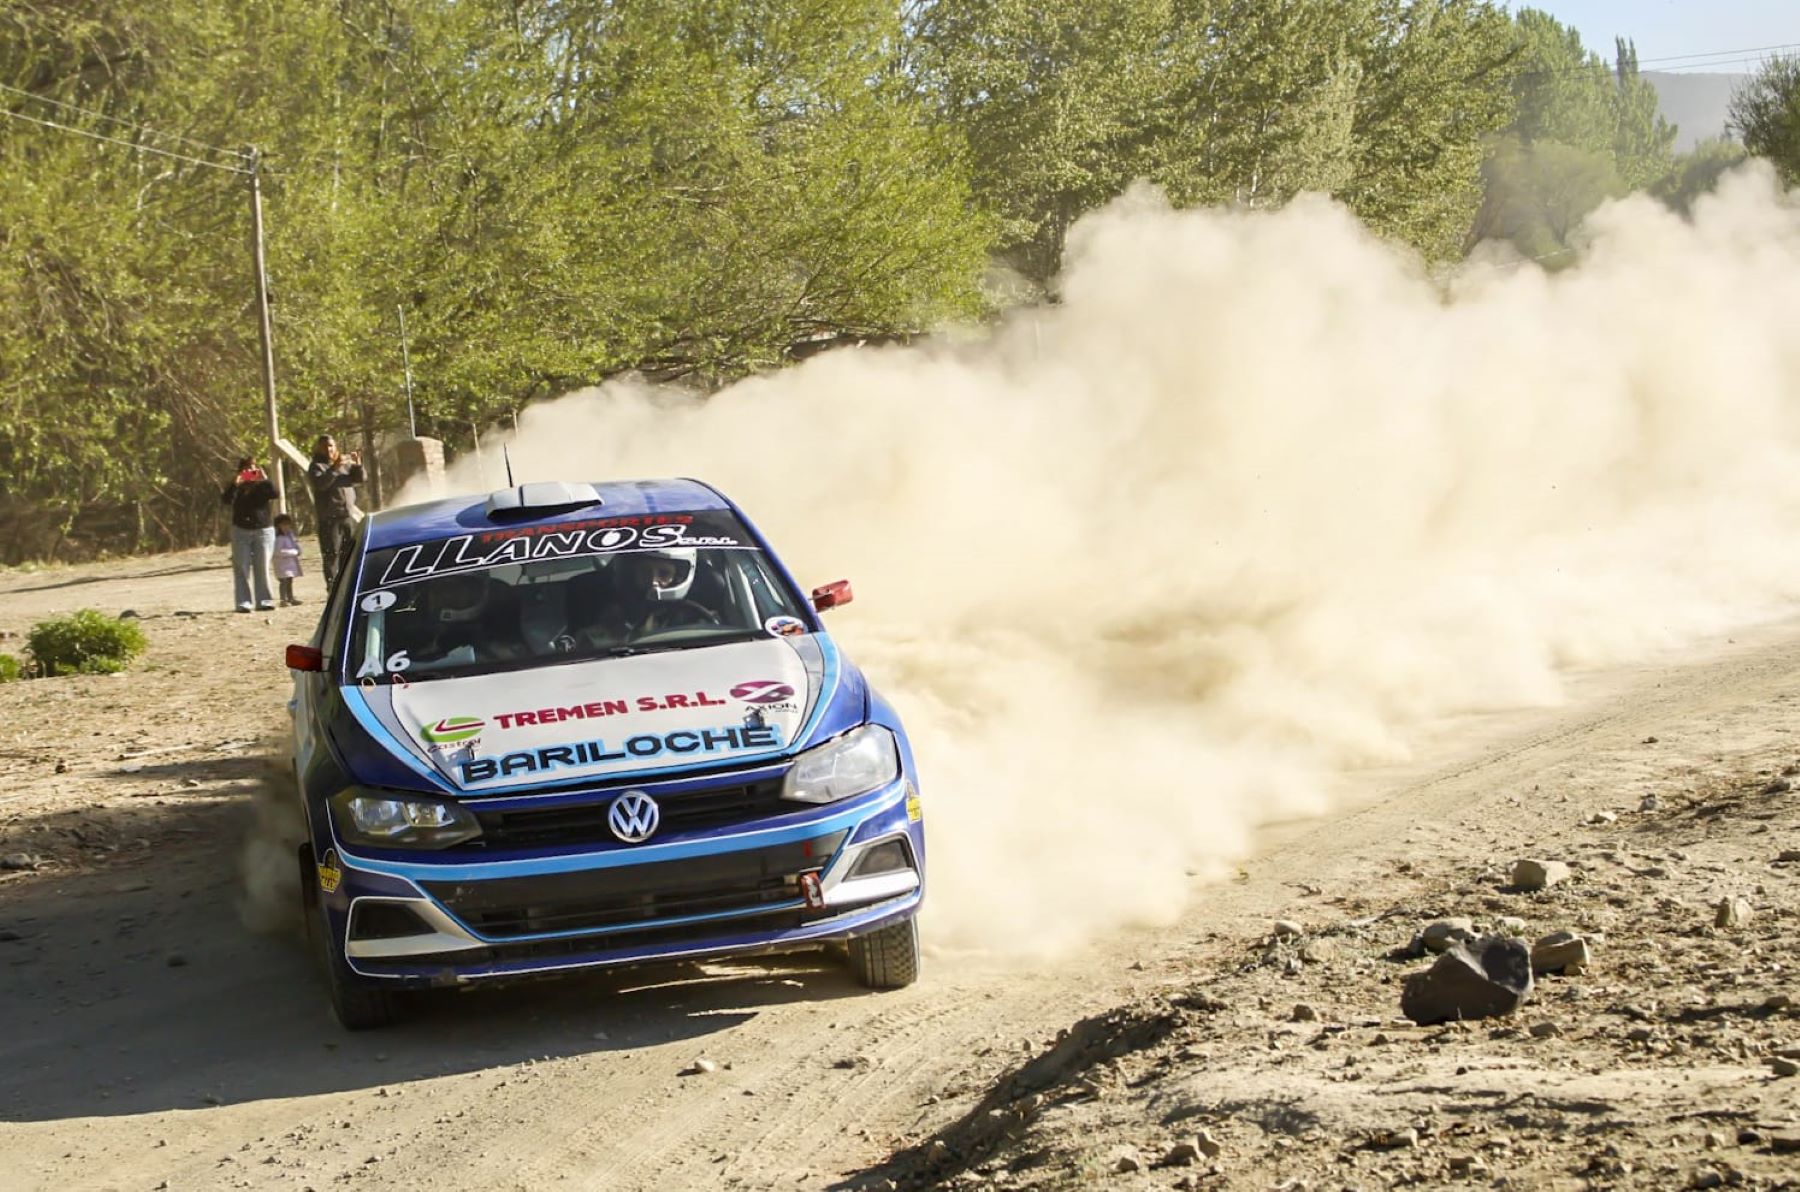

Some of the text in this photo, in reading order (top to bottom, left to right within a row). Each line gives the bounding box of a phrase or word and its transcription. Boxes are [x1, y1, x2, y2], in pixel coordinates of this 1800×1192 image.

[481, 515, 693, 544] TRANSPORTES
[380, 524, 687, 585] LLANOS
[493, 691, 727, 730] TREMEN S.R.L.
[461, 726, 778, 784] BARILOCHE
